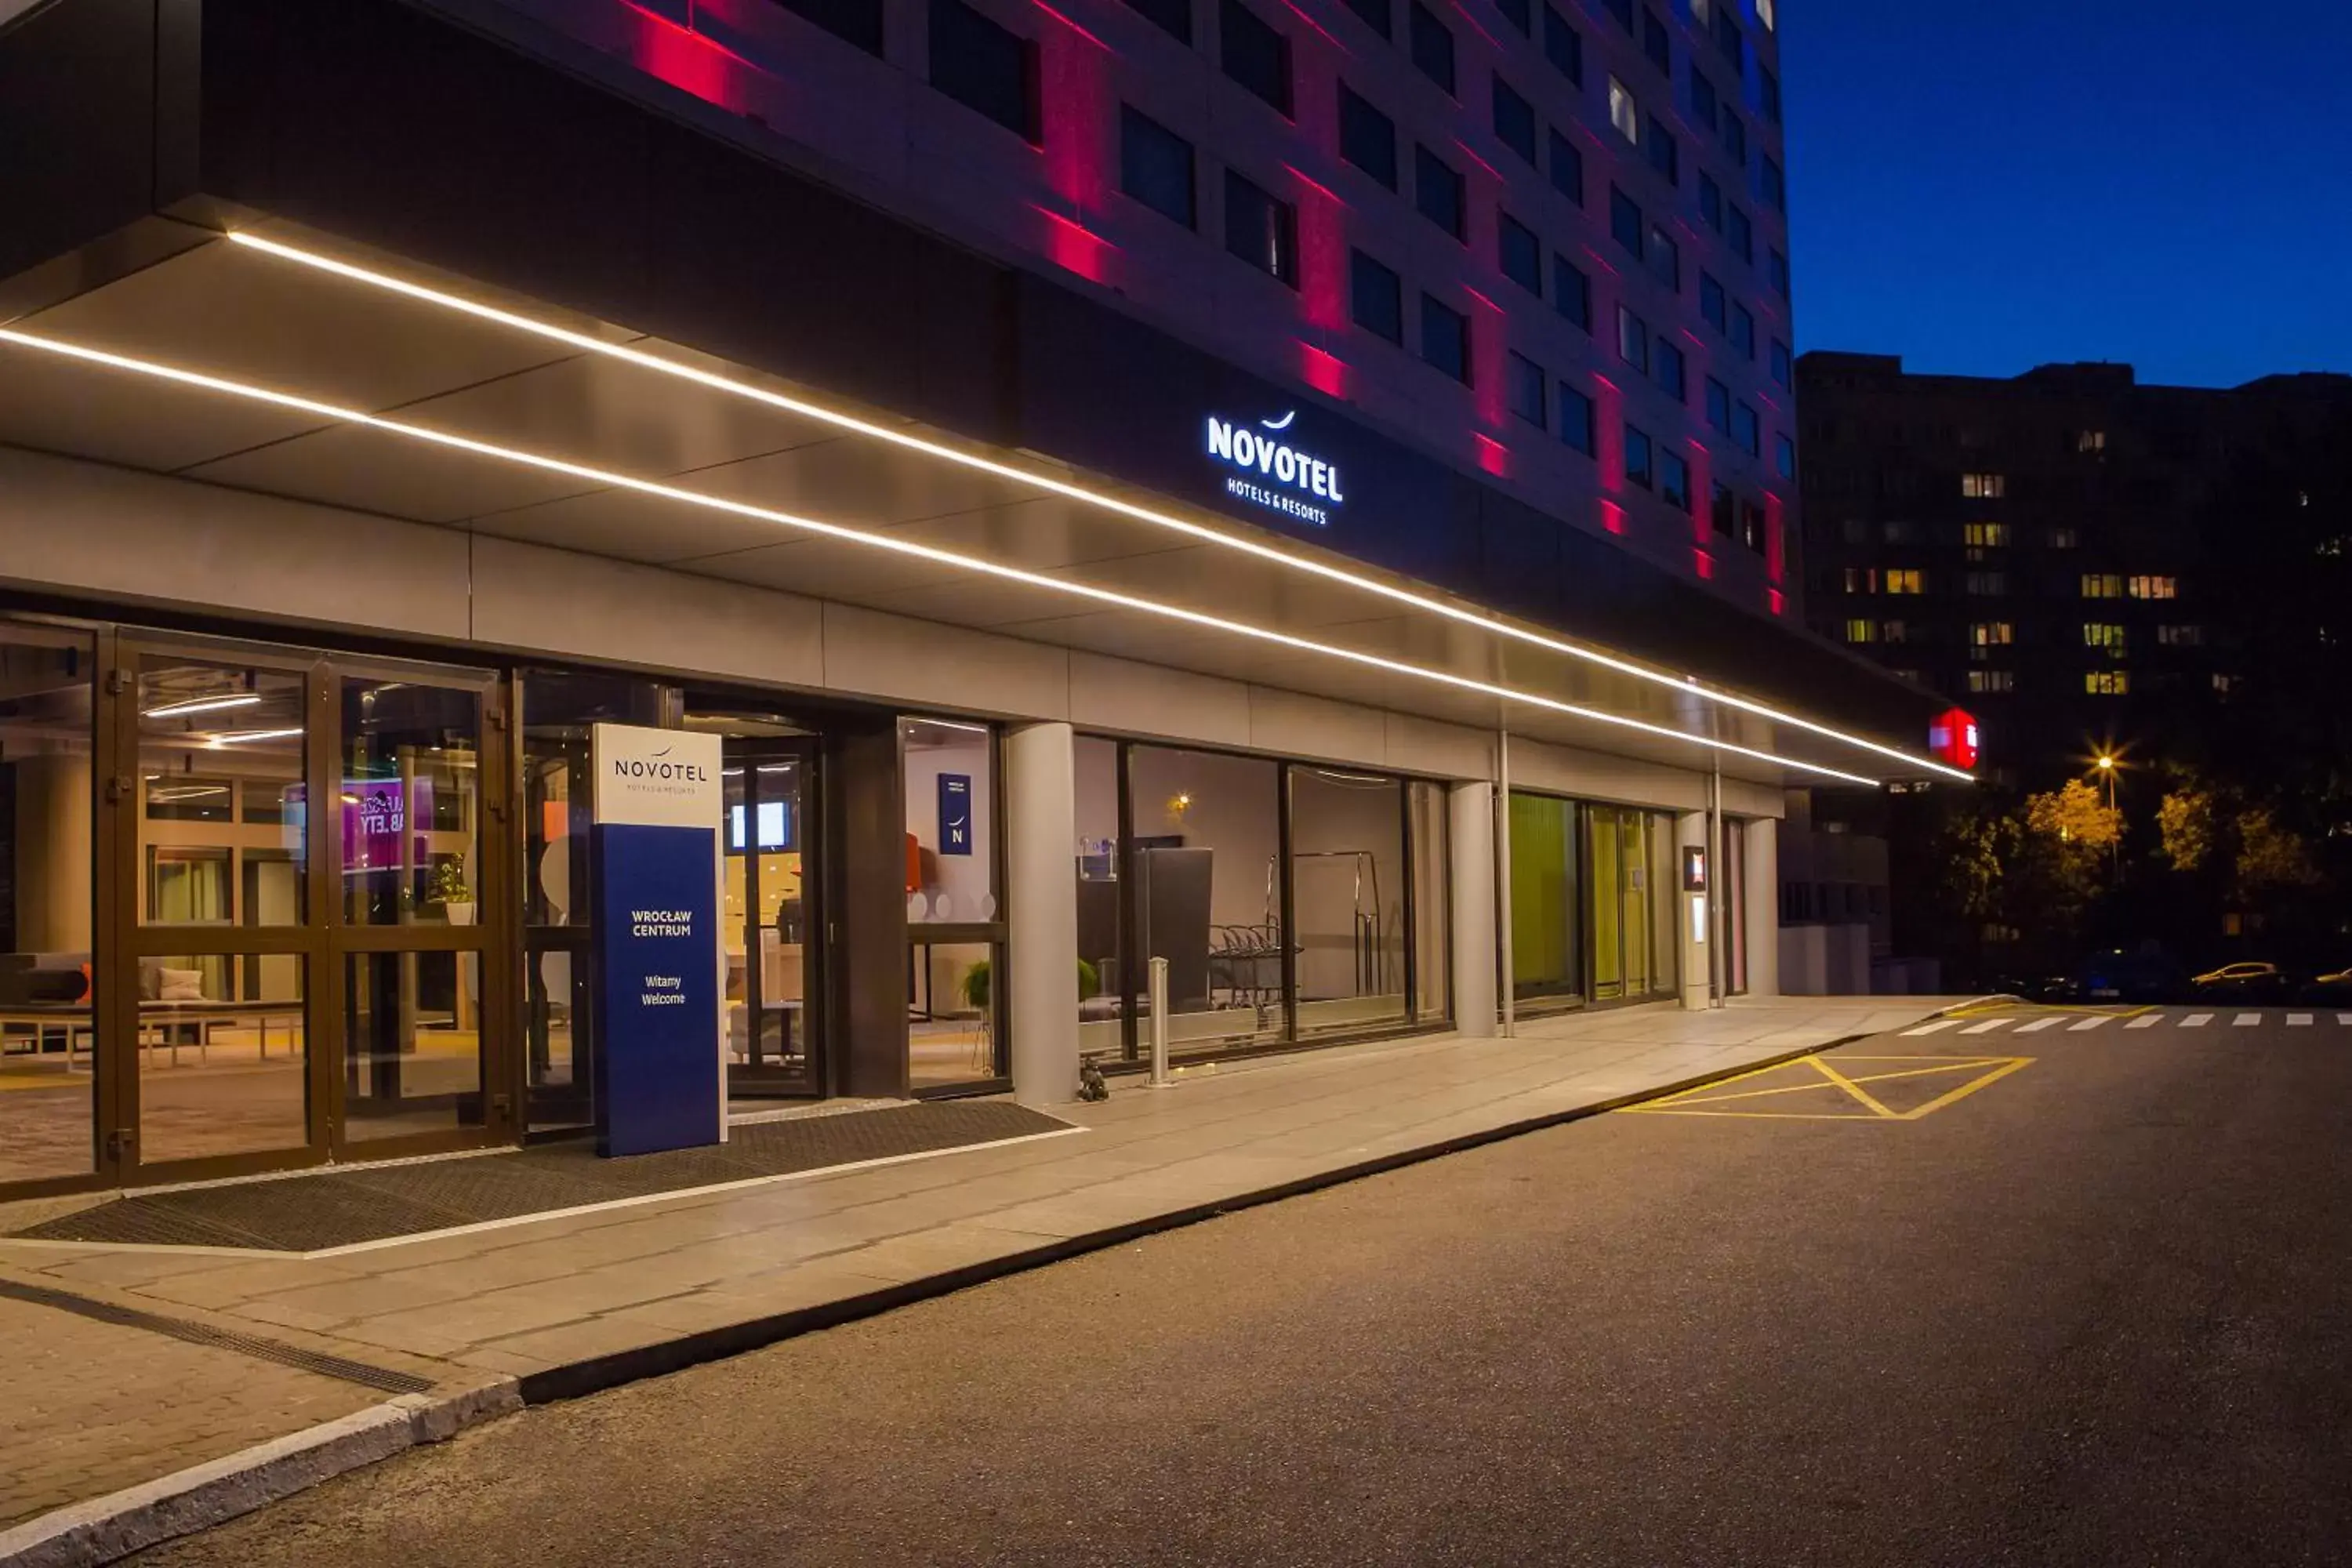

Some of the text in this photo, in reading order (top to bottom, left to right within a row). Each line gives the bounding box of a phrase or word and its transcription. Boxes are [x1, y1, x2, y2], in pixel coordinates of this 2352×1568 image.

[1207, 416, 1343, 503] NOVOTEL
[1228, 477, 1327, 525] HOTELS & RESORTS
[615, 760, 707, 782] NOVOTEL
[953, 829, 963, 844] N
[631, 910, 692, 923] WROCŁAW
[633, 924, 691, 937] CENTRUM
[645, 975, 681, 990] Witamy
[641, 993, 686, 1006] Welcome
